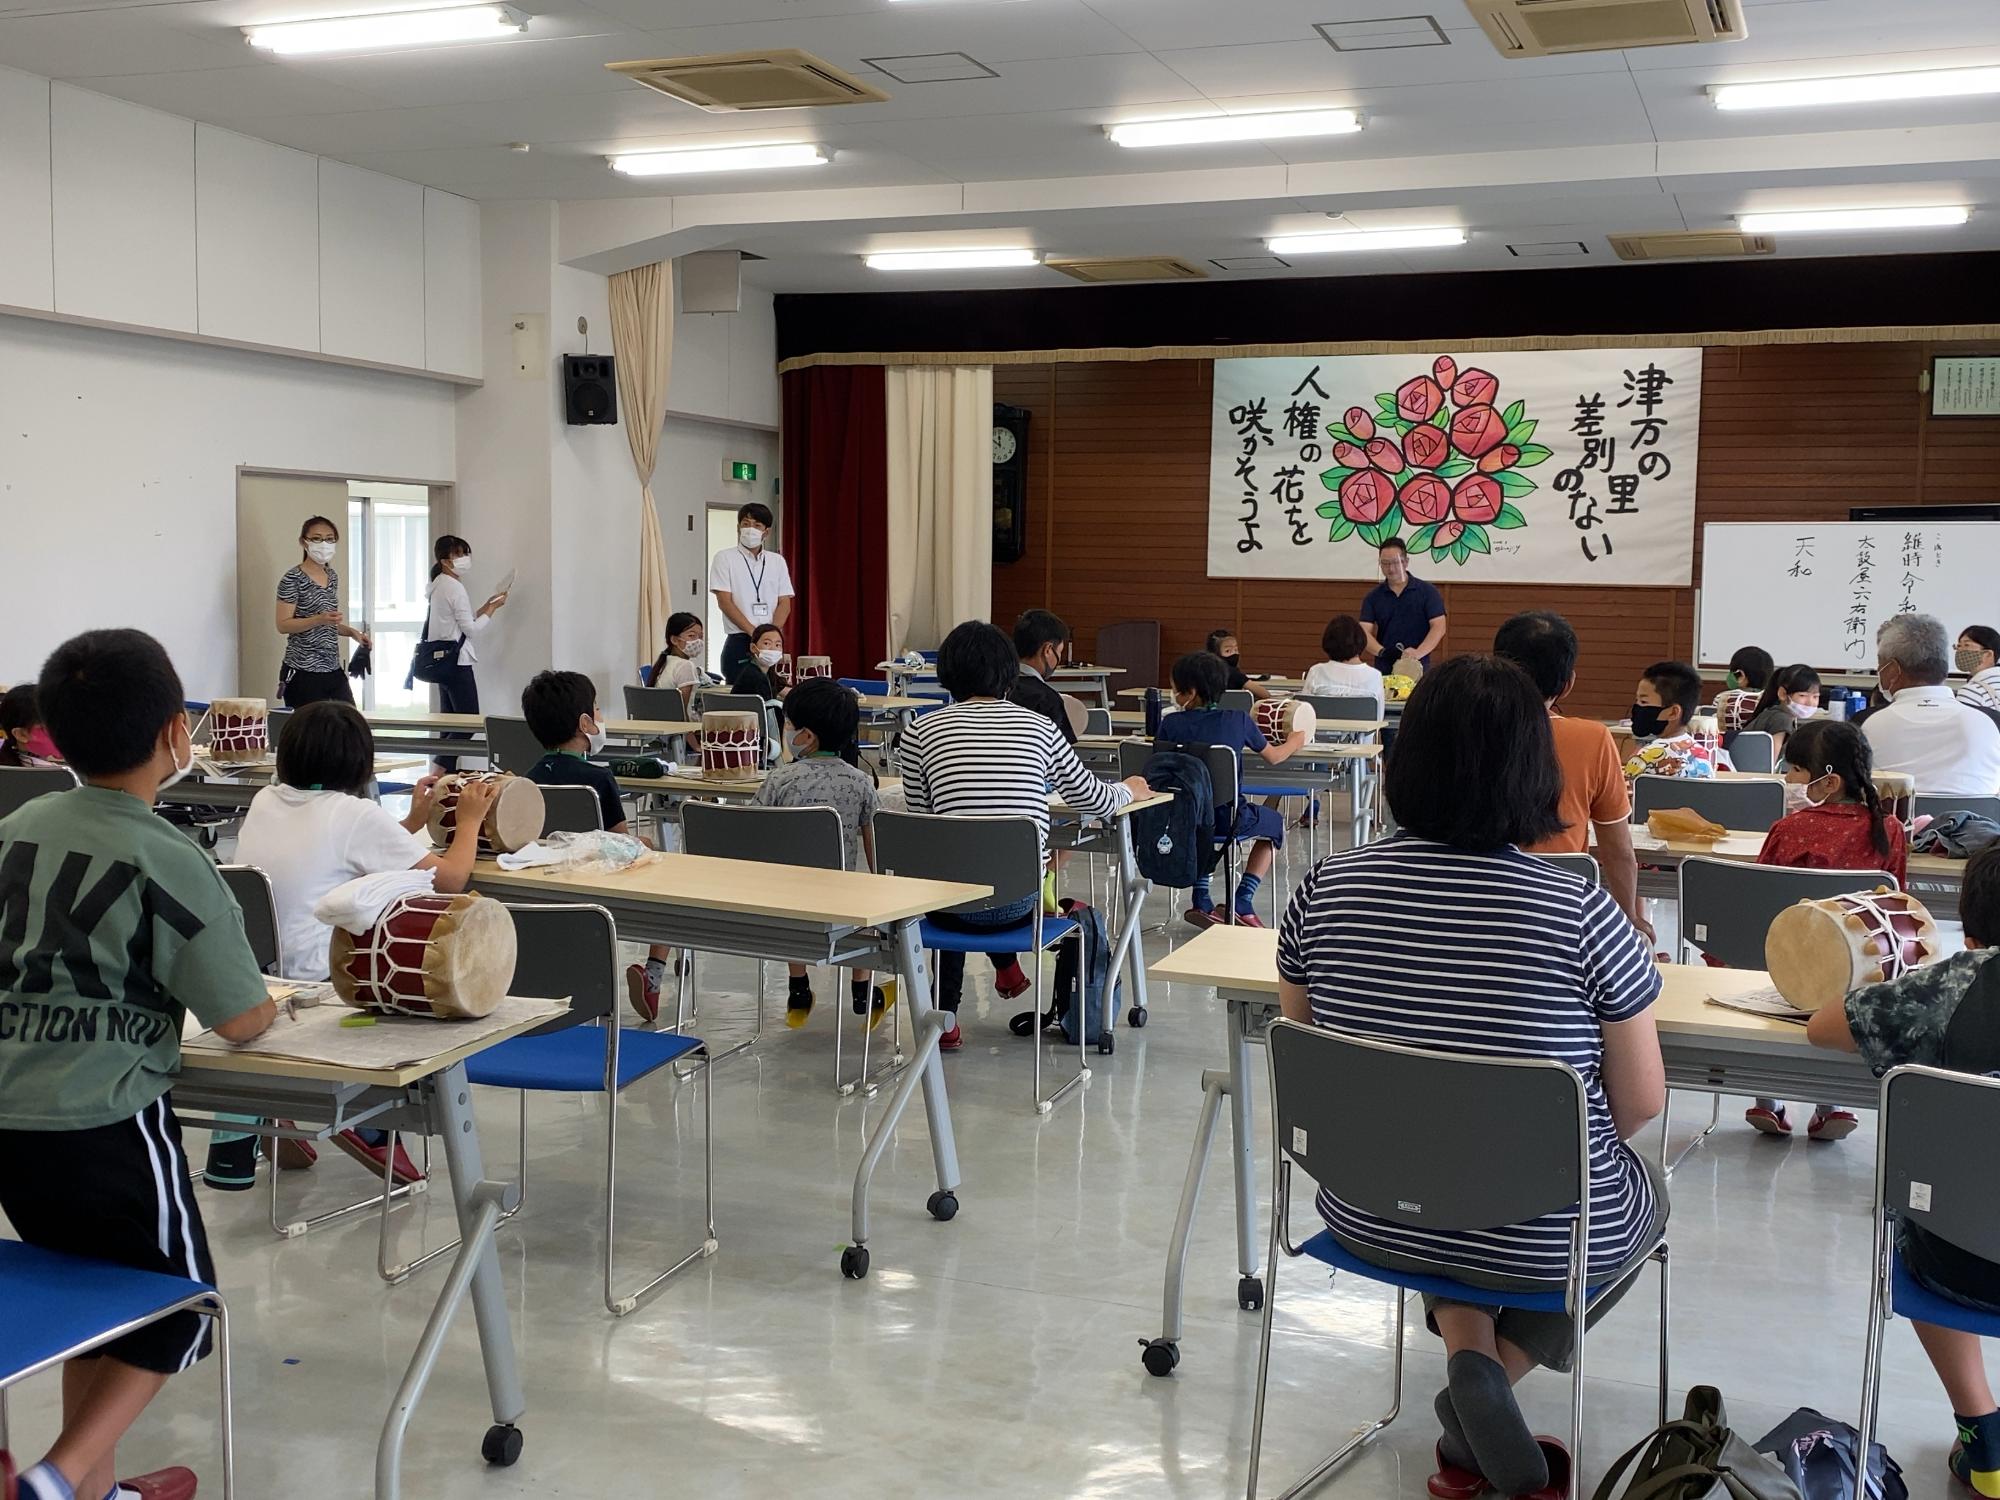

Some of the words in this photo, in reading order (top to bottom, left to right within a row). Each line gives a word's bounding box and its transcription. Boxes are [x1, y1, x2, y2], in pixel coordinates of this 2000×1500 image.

[1228, 396, 1275, 553] 咲かそうよ
[1270, 365, 1331, 545] 人権の花を
[1552, 392, 1616, 562] 差別のない
